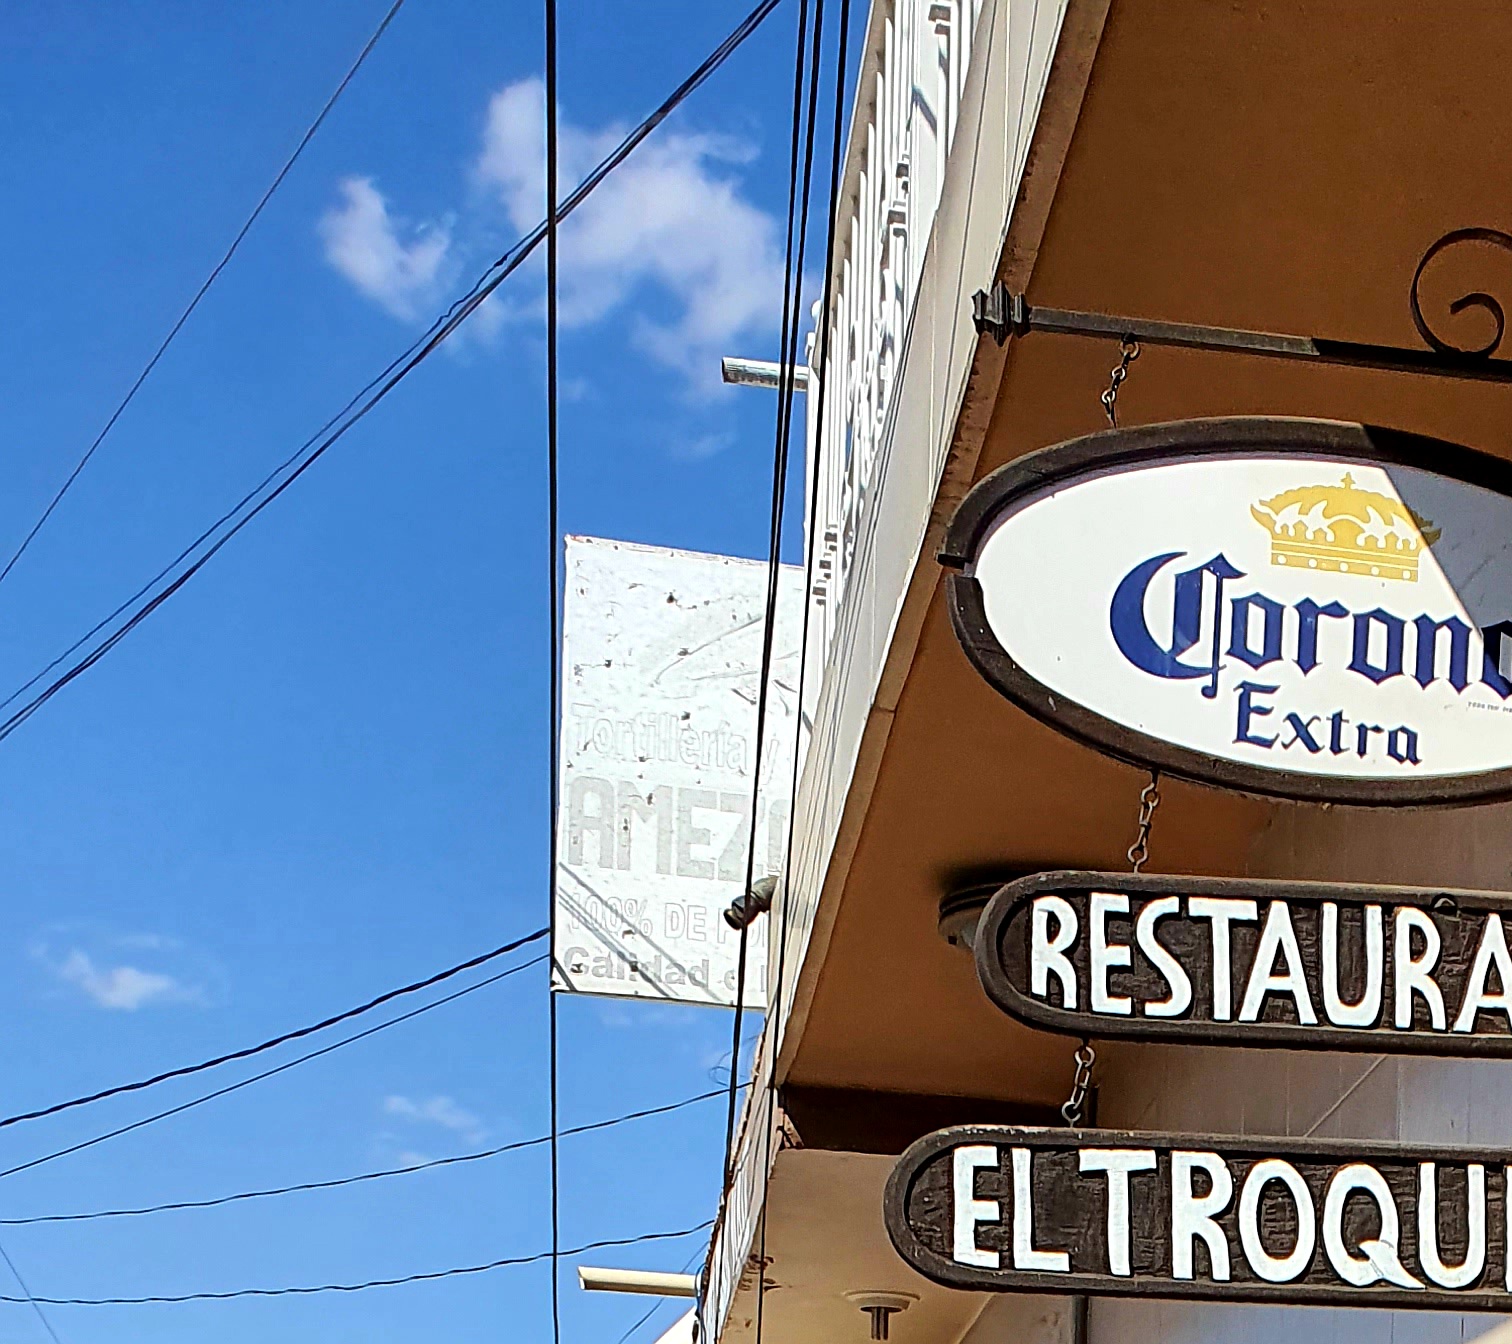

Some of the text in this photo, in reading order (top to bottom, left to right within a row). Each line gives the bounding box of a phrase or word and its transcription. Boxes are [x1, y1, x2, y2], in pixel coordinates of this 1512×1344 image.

[1232, 682, 1422, 766] Extra
[664, 902, 707, 942] DE
[951, 1146, 1070, 1274] EL
